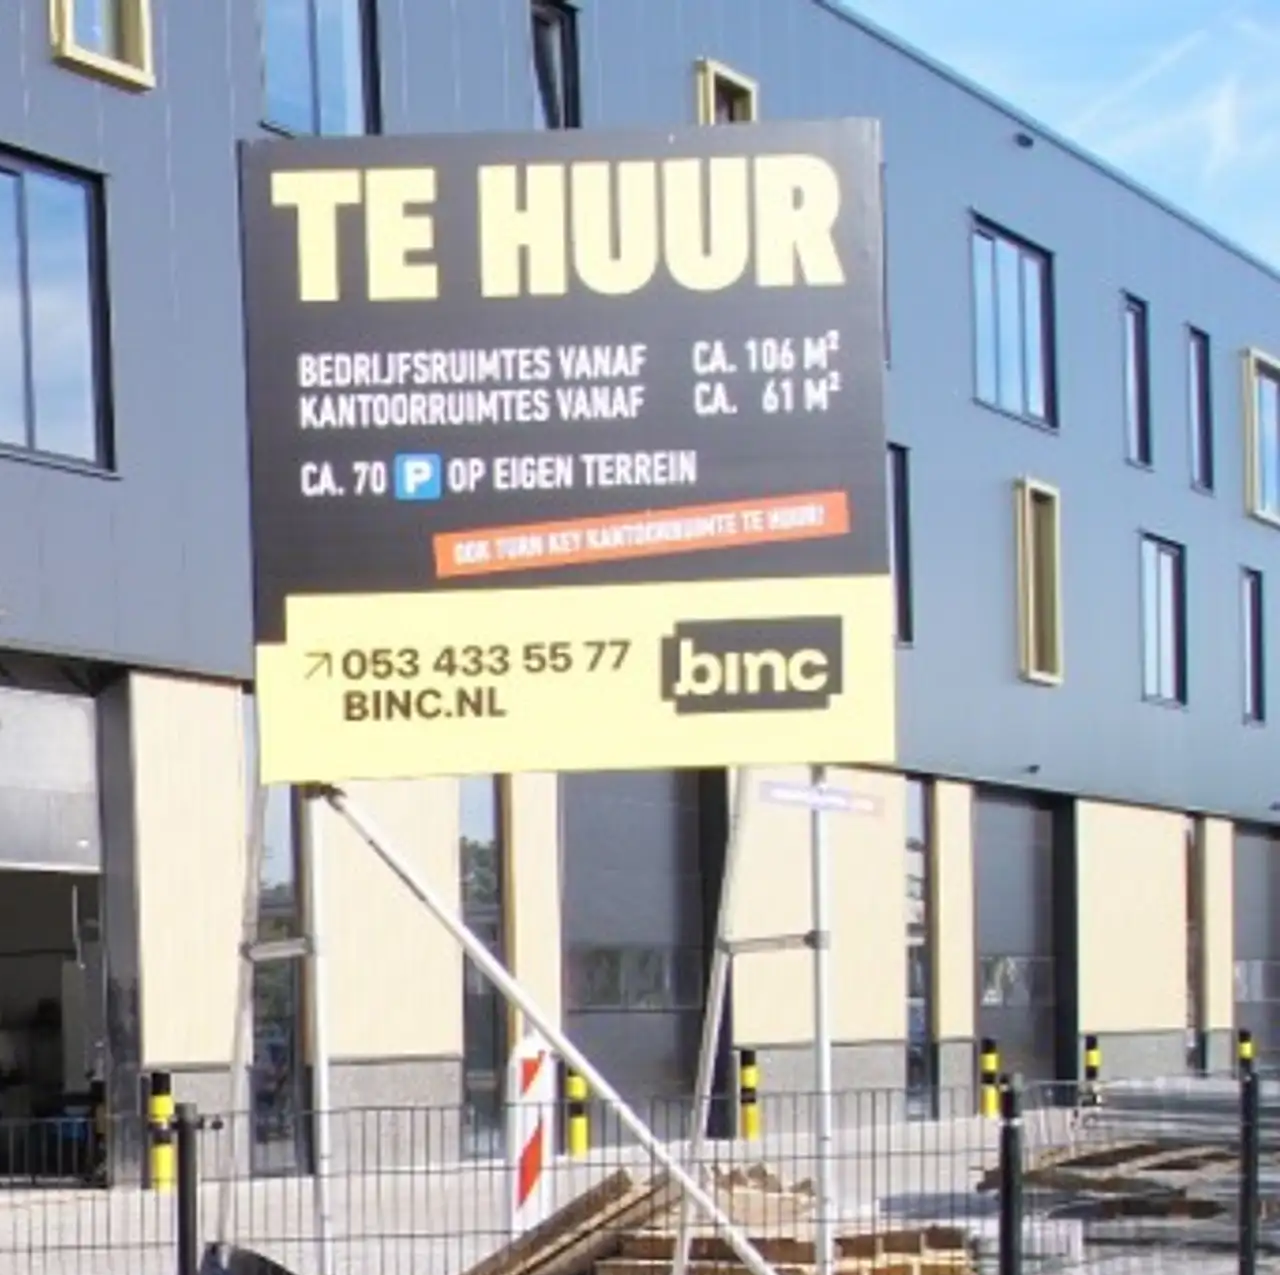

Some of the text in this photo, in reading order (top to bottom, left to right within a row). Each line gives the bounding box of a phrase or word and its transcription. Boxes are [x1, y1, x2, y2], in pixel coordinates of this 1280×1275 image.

[271, 154, 845, 302] TE HUUR
[297, 348, 552, 388] BEDRIJFSRUIMTES
[557, 344, 647, 381] VANAF
[692, 340, 738, 375] CA.
[745, 337, 795, 373] 106
[299, 388, 551, 430] KANTOORRUIMTES
[556, 384, 646, 421] VANAF
[693, 380, 738, 416] CA.
[761, 378, 794, 415] 61
[300, 450, 697, 497] CA. 70 P OP EIGEN TERREIN
[341, 639, 632, 681] 053 433 55 77
[673, 639, 830, 696] binc
[343, 686, 508, 722] BINC.NL
